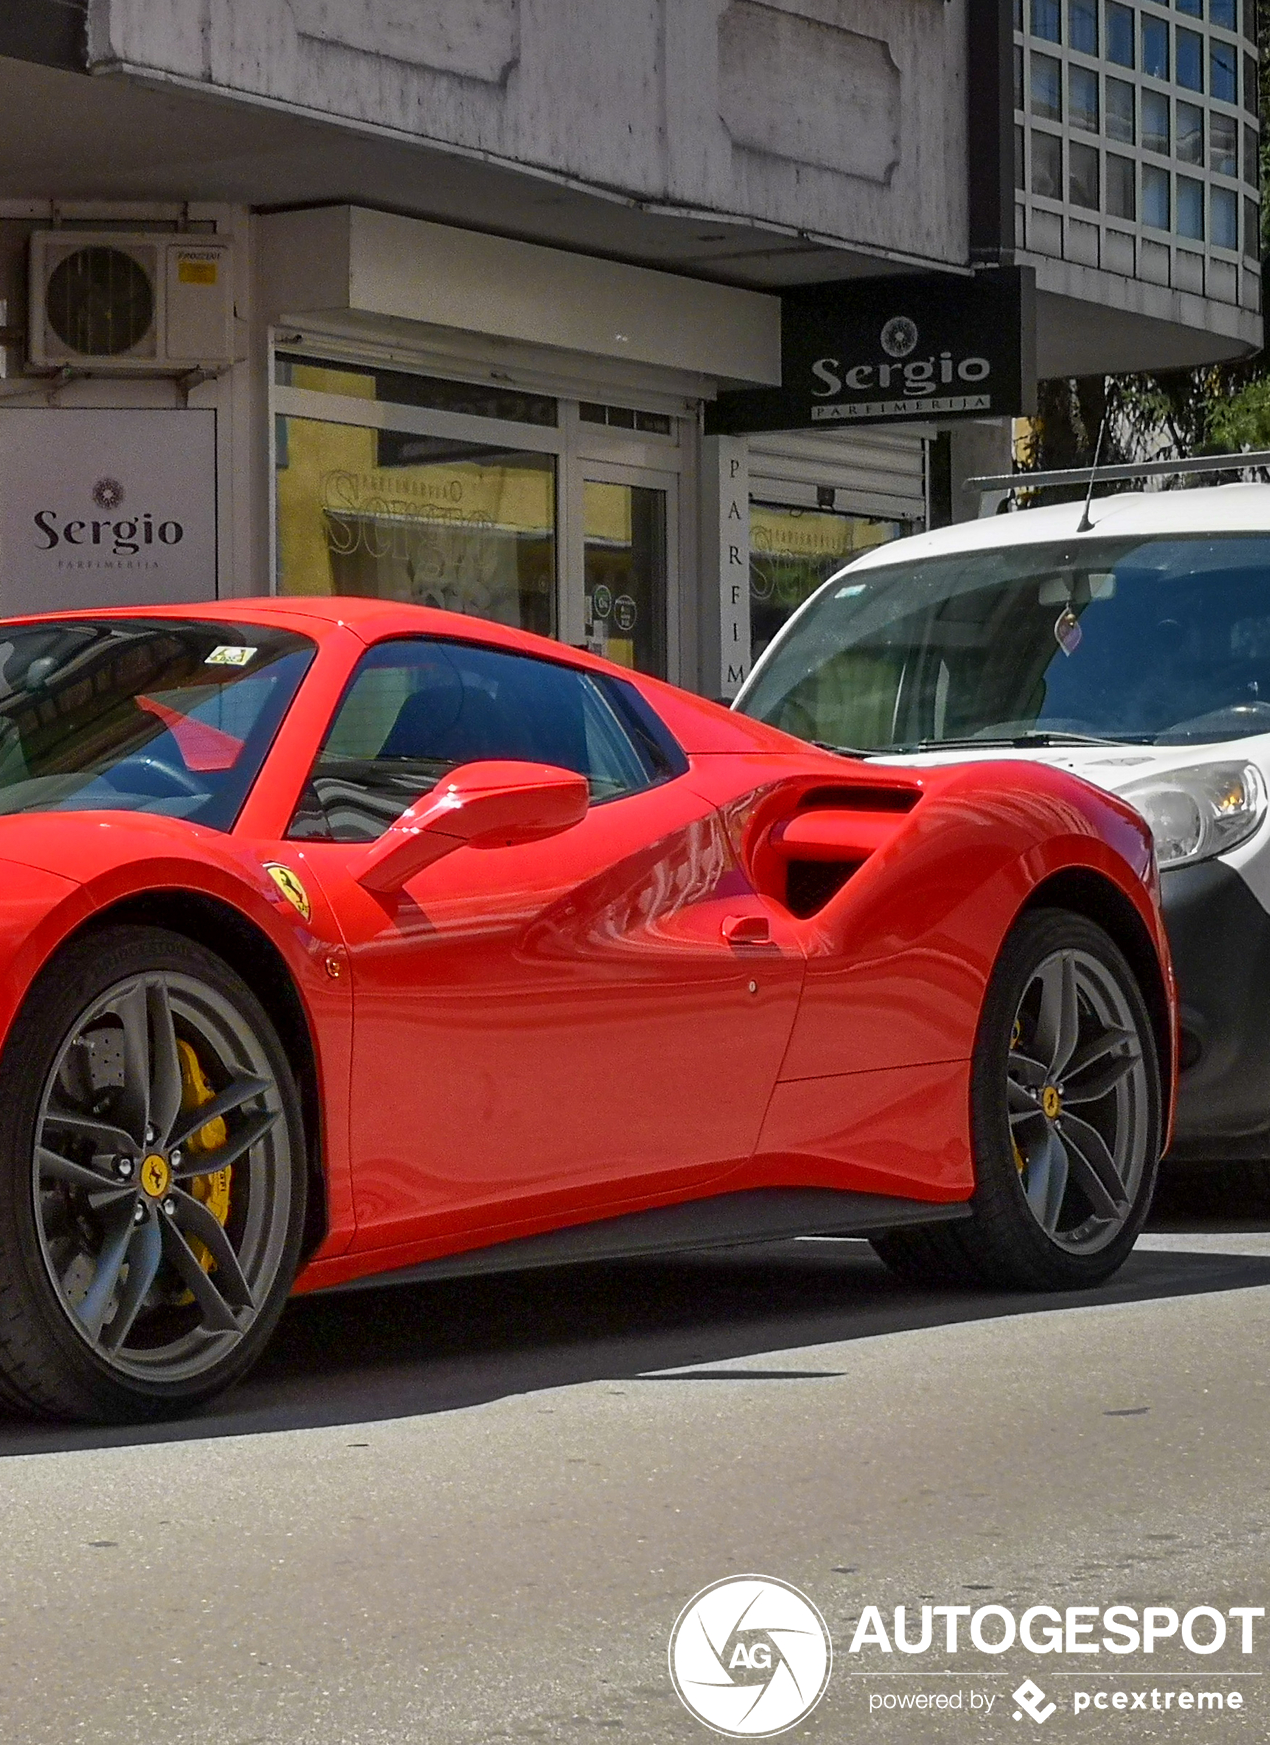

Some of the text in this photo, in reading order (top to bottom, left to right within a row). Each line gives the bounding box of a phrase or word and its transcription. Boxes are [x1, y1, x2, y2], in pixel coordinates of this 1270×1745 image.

[811, 351, 991, 397] Sergio
[816, 397, 986, 417] PARFIMERIJA
[33, 510, 184, 556] Sergio
